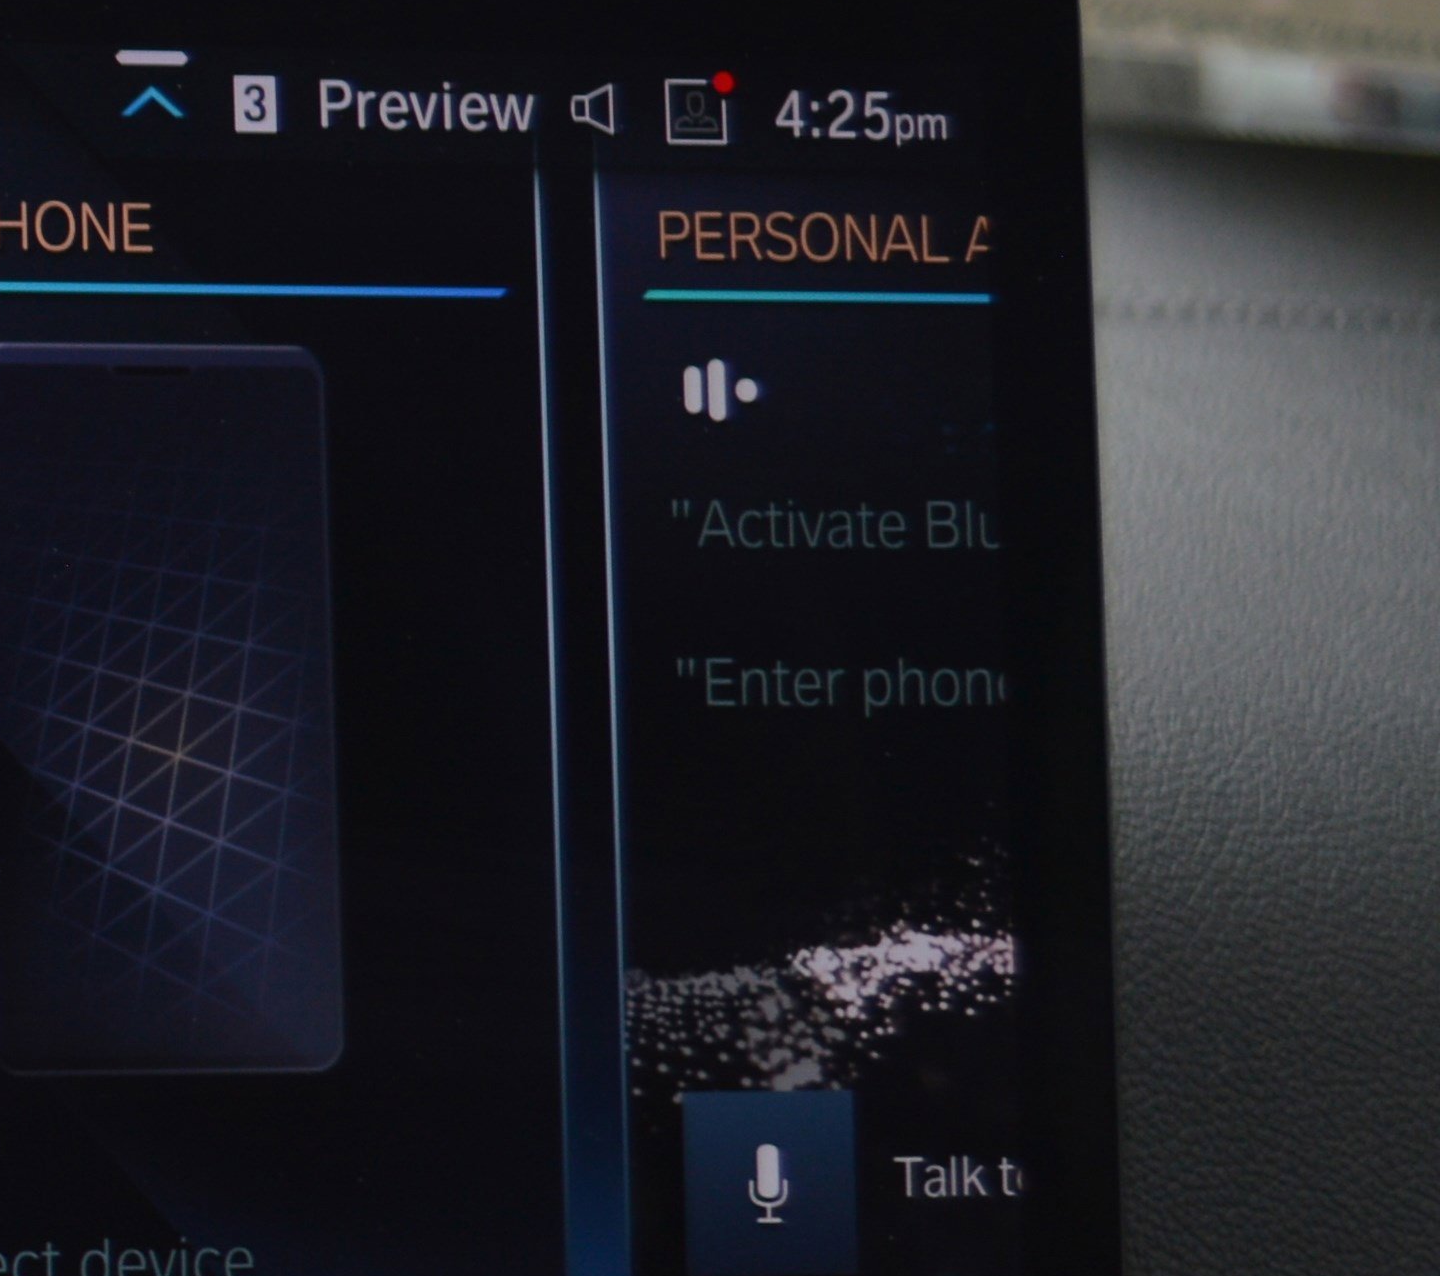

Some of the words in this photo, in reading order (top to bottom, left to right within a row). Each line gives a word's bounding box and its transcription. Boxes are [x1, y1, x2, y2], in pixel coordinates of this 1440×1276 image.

[319, 78, 535, 132] Preview
[775, 89, 948, 147] 4:25pm
[658, 210, 950, 263] PERSONAL
[671, 498, 908, 549] "Activate
[676, 656, 845, 707] "Enter
[893, 1155, 988, 1198] Talk
